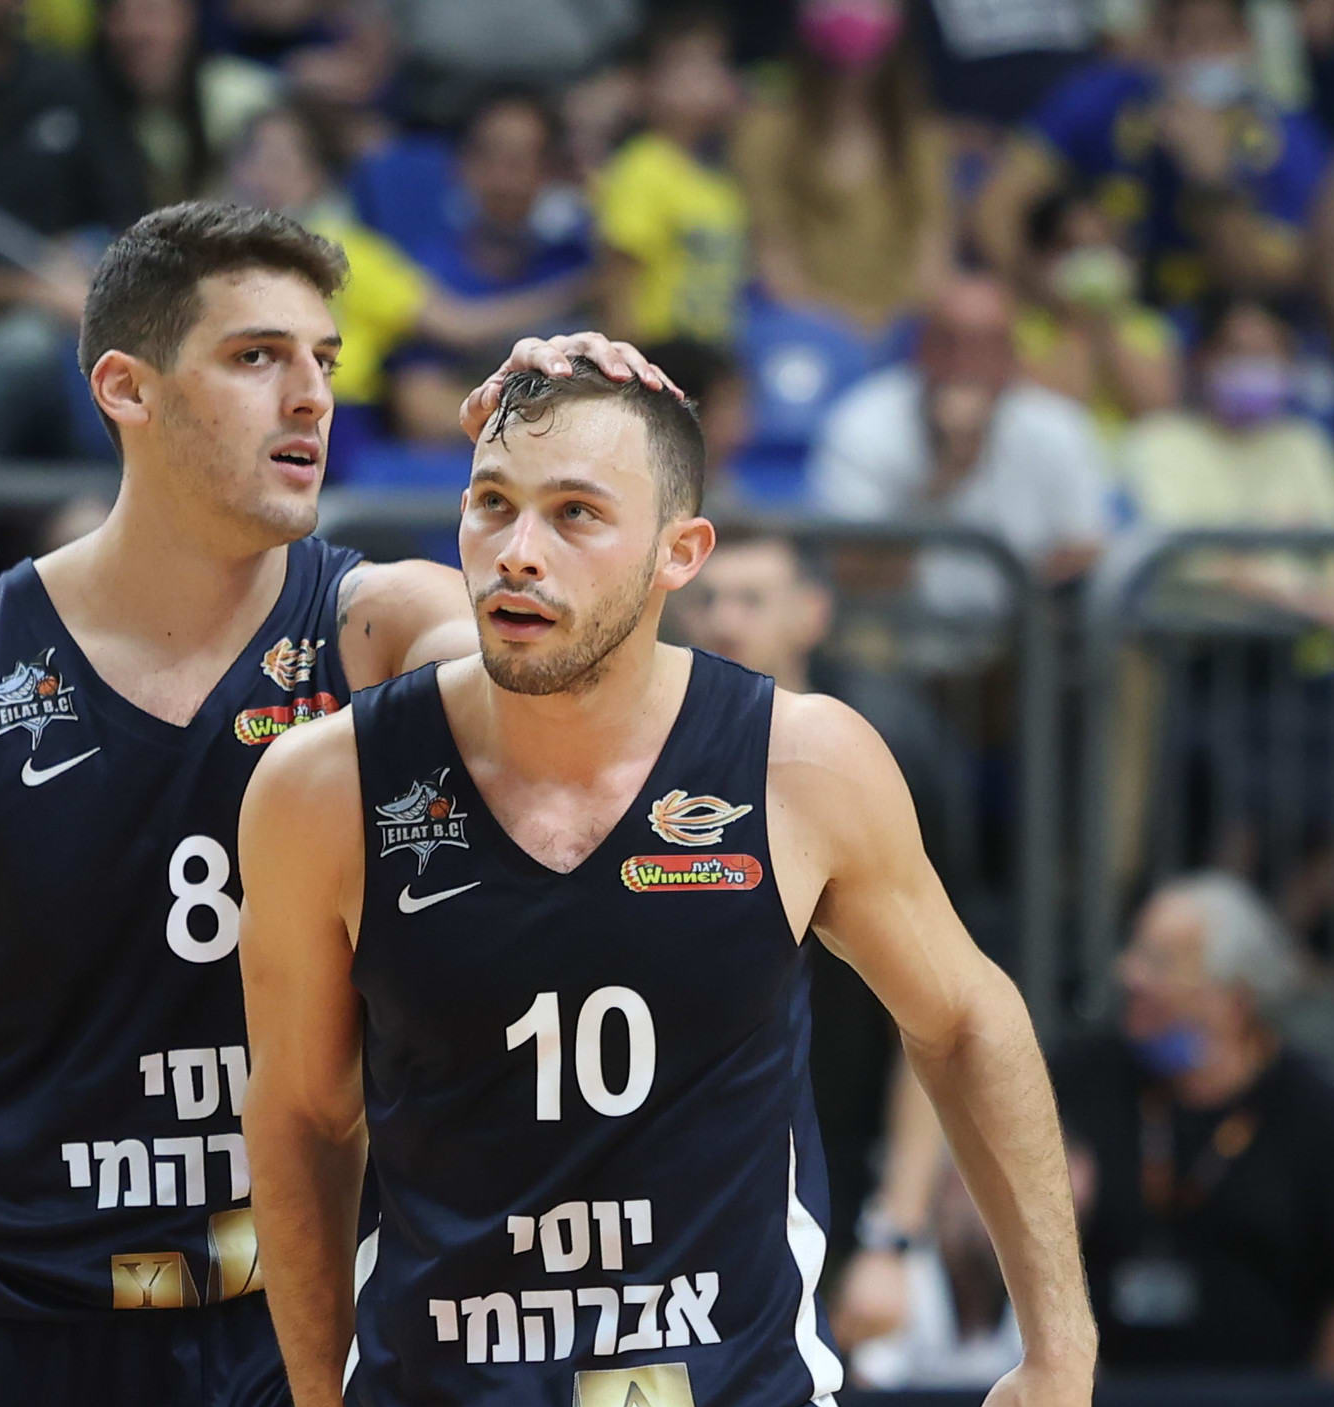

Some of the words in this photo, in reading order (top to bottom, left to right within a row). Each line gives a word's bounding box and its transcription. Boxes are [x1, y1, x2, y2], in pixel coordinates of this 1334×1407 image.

[0, 703, 38, 724] EILAT
[387, 826, 428, 844] EILAT
[692, 858, 721, 872] ליגת
[166, 835, 240, 963] 8
[637, 865, 722, 885] Winner
[724, 868, 744, 883] סל
[506, 985, 656, 1121] 10
[139, 1046, 250, 1121] וסי
[61, 1133, 252, 1210] רהמי
[507, 1199, 652, 1273] יוסי
[119, 1261, 173, 1307] Y
[429, 1271, 721, 1364] אברהמי
